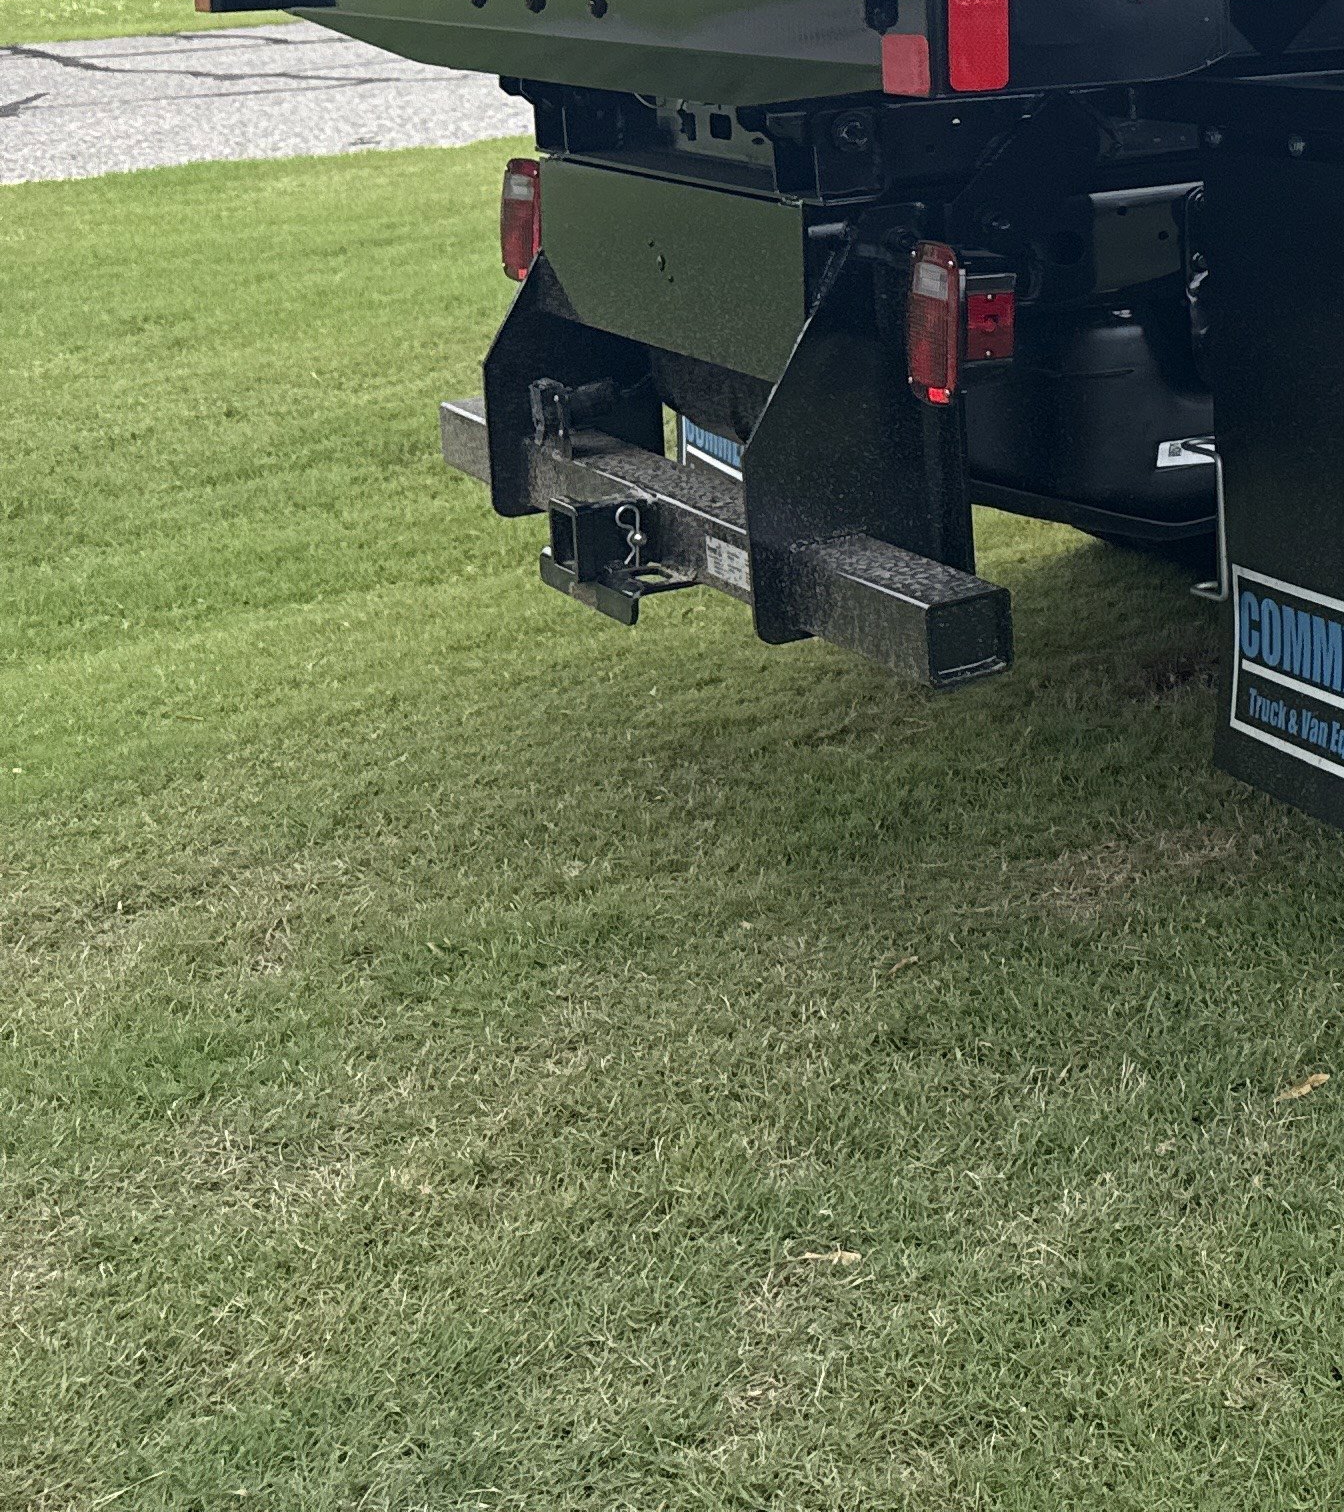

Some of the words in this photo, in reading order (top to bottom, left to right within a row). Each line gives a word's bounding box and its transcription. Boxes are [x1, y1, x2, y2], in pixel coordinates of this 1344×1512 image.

[1249, 686, 1286, 731] Truck
[1287, 708, 1299, 736] &
[1301, 707, 1329, 749] Van
